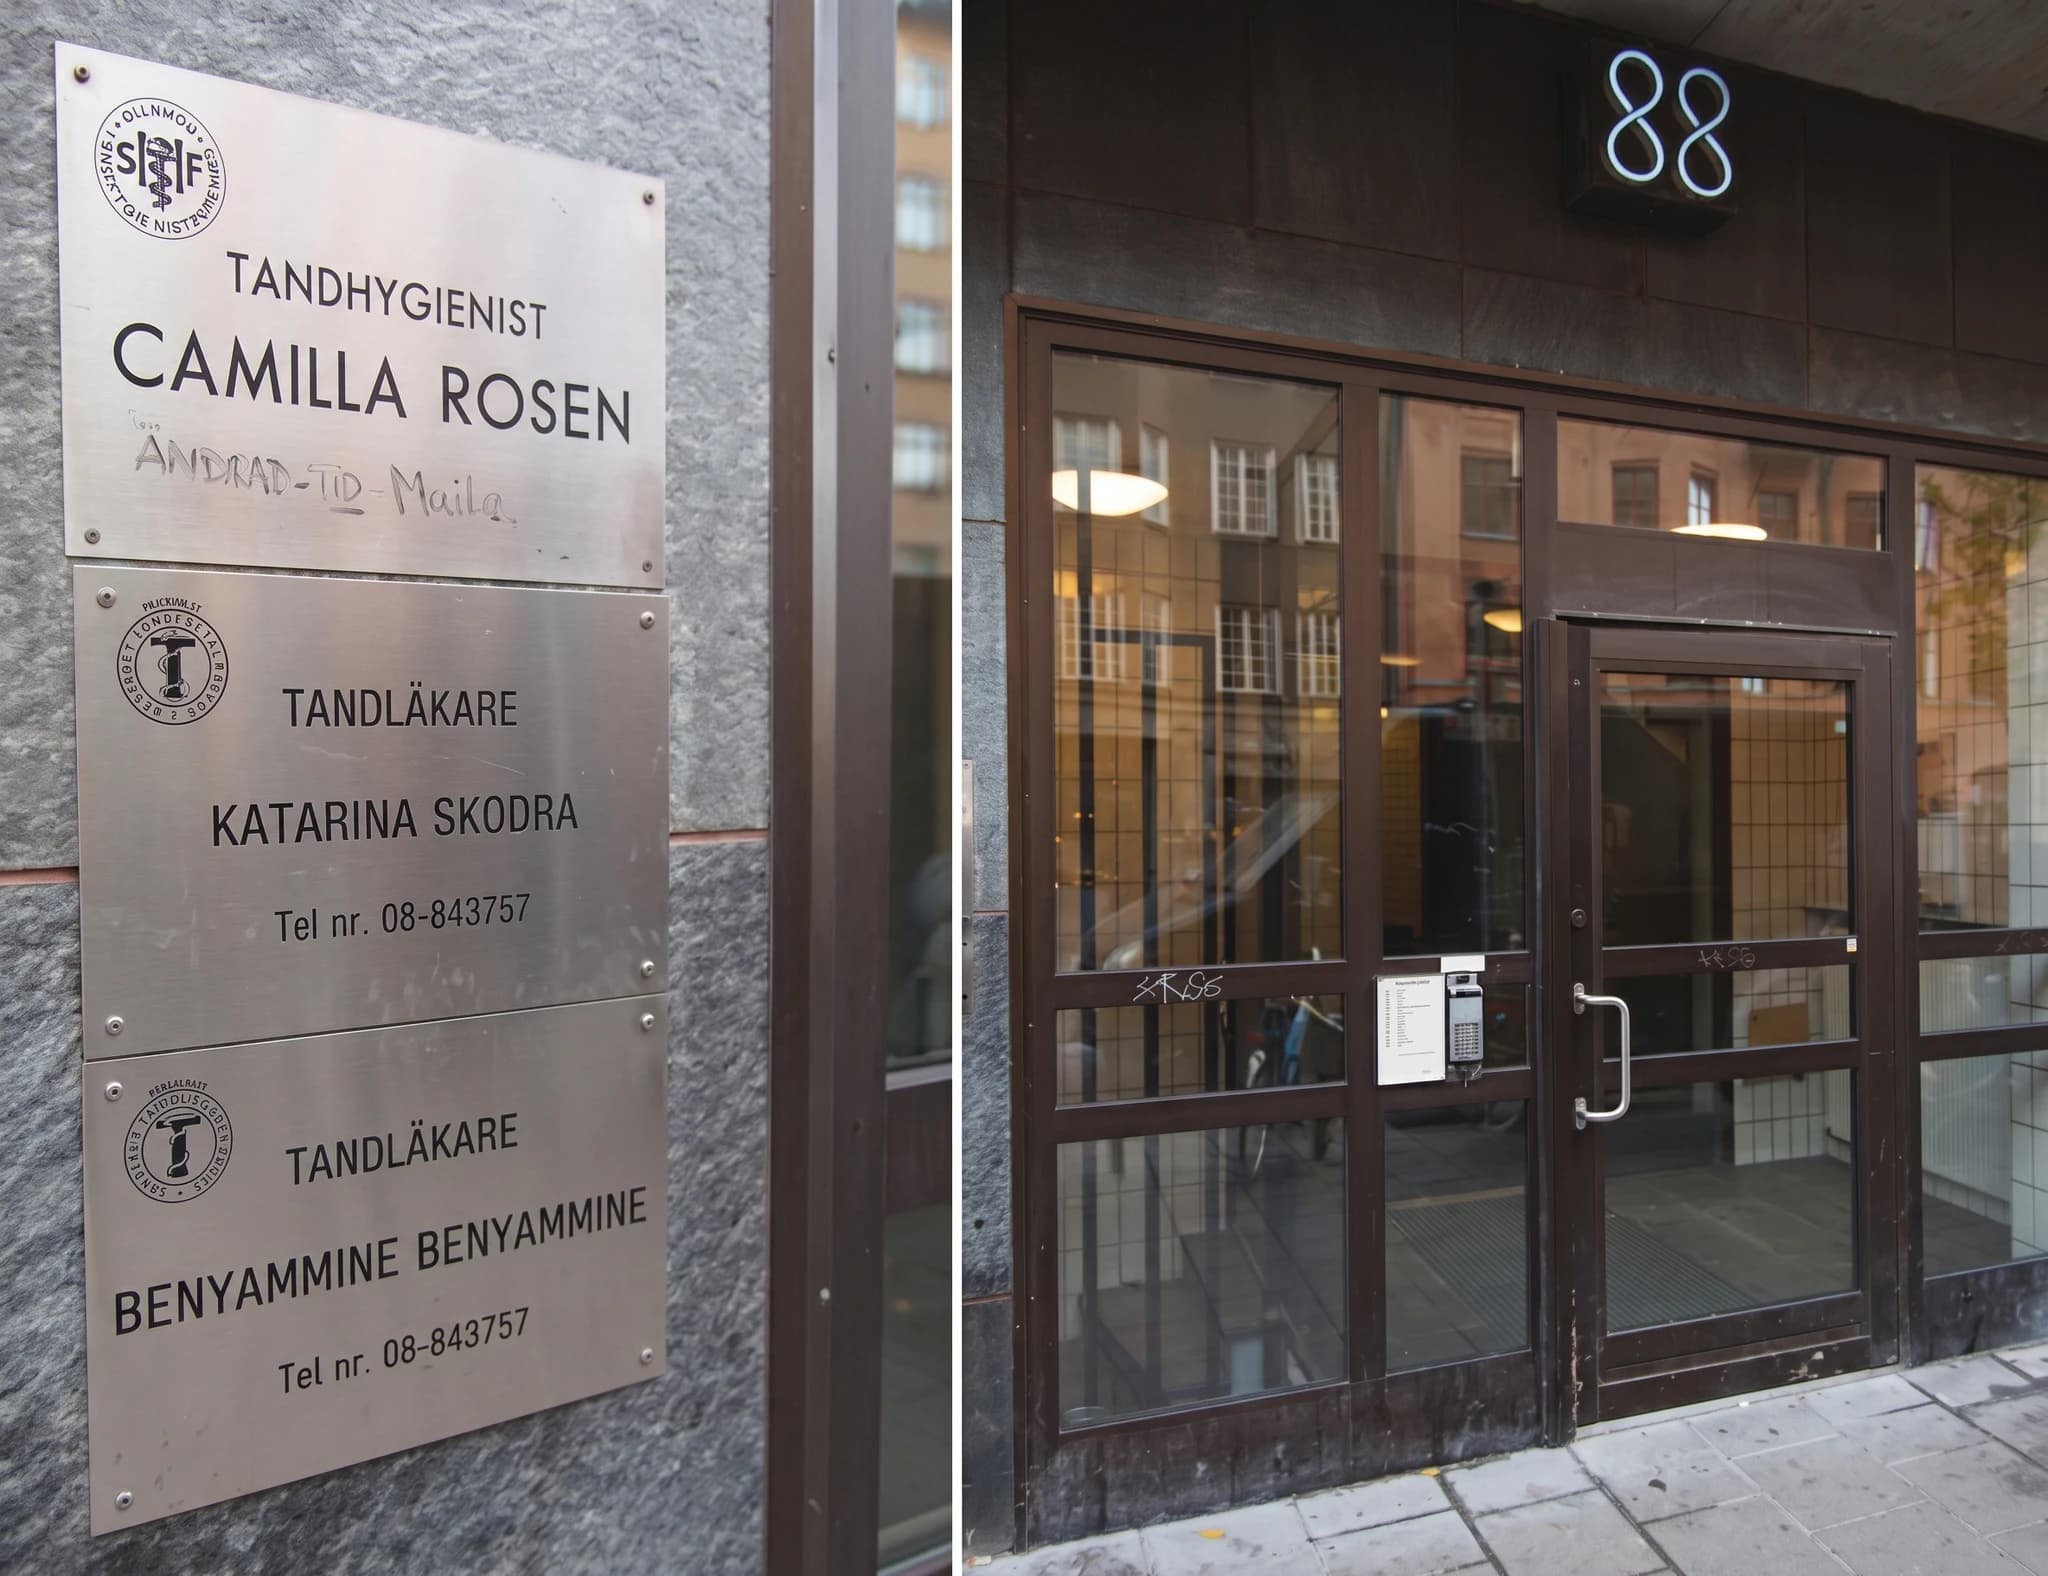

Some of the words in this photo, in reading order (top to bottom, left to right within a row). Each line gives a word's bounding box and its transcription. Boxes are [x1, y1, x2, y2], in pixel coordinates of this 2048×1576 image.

[1607, 51, 1732, 197] 88
[226, 251, 547, 340] TANDHYGIENIST
[113, 322, 408, 419] CAMILLA
[441, 365, 630, 445] ROSEN
[282, 681, 518, 727] TANDLÄKARE
[212, 799, 417, 846] KATARINA
[434, 793, 578, 836] SKODRA
[275, 908, 318, 942] Tel
[332, 913, 369, 938] nr.
[381, 893, 531, 934] 08-843757
[286, 1113, 519, 1185] TANDLÄKARE
[116, 1237, 400, 1336] BENYAMMINE
[417, 1187, 648, 1271] BENYAMMINE
[278, 1357, 323, 1394] Tel
[335, 1353, 371, 1382] nr.
[384, 1307, 530, 1368] 08-843757
